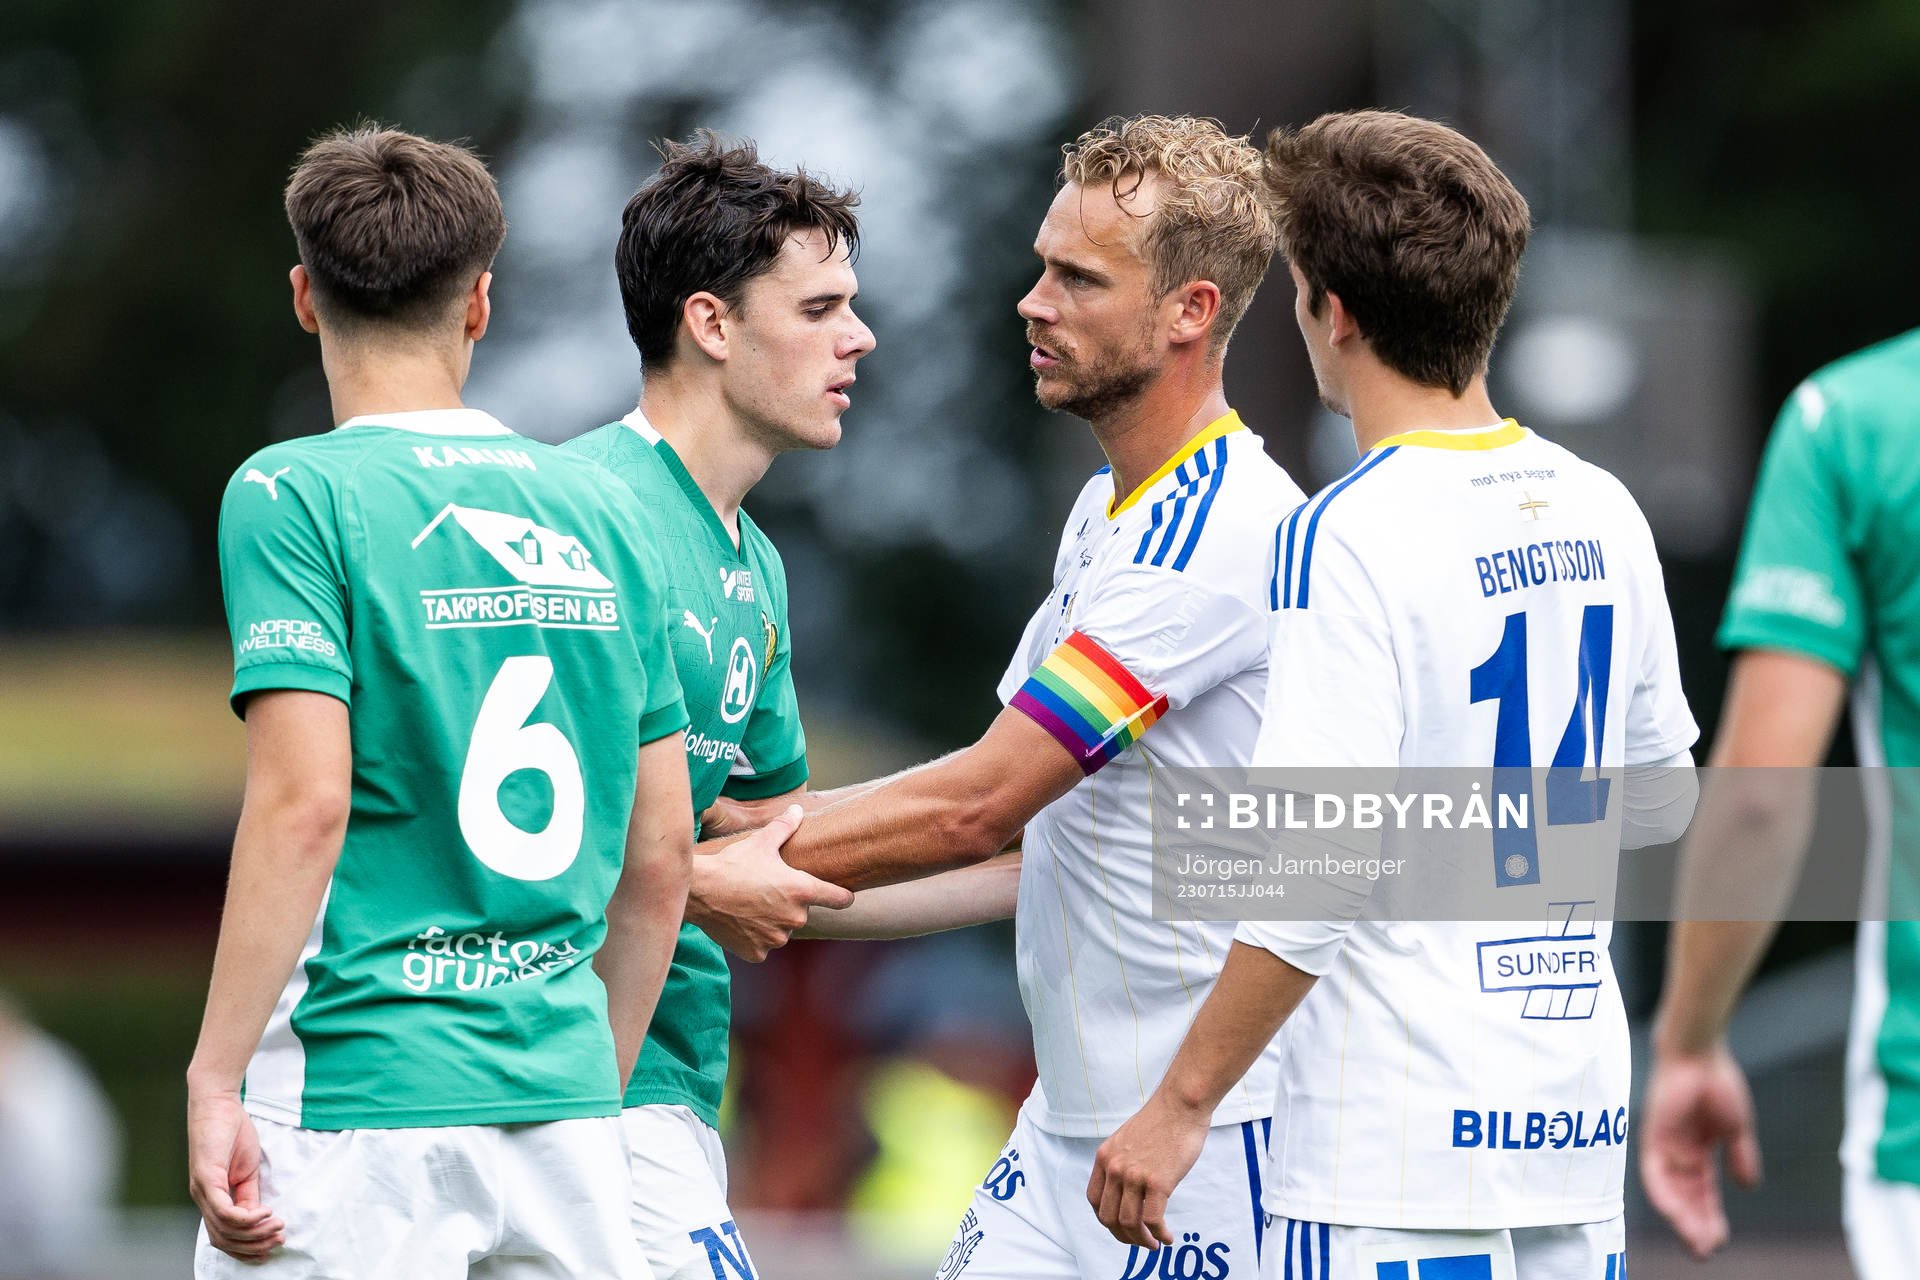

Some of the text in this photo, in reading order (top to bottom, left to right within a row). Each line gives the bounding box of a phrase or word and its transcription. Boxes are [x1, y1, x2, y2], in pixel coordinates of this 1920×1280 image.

[1470, 473, 1498, 487] mot
[1499, 471, 1522, 482] nya
[1475, 539, 1606, 598] BENGTSSON
[586, 600, 618, 623] AB
[250, 619, 322, 637] NORDIC
[239, 633, 337, 657] WELLNESS
[1470, 604, 1614, 889] 14
[457, 655, 585, 882] 6
[1497, 950, 1600, 977] SUNDFR
